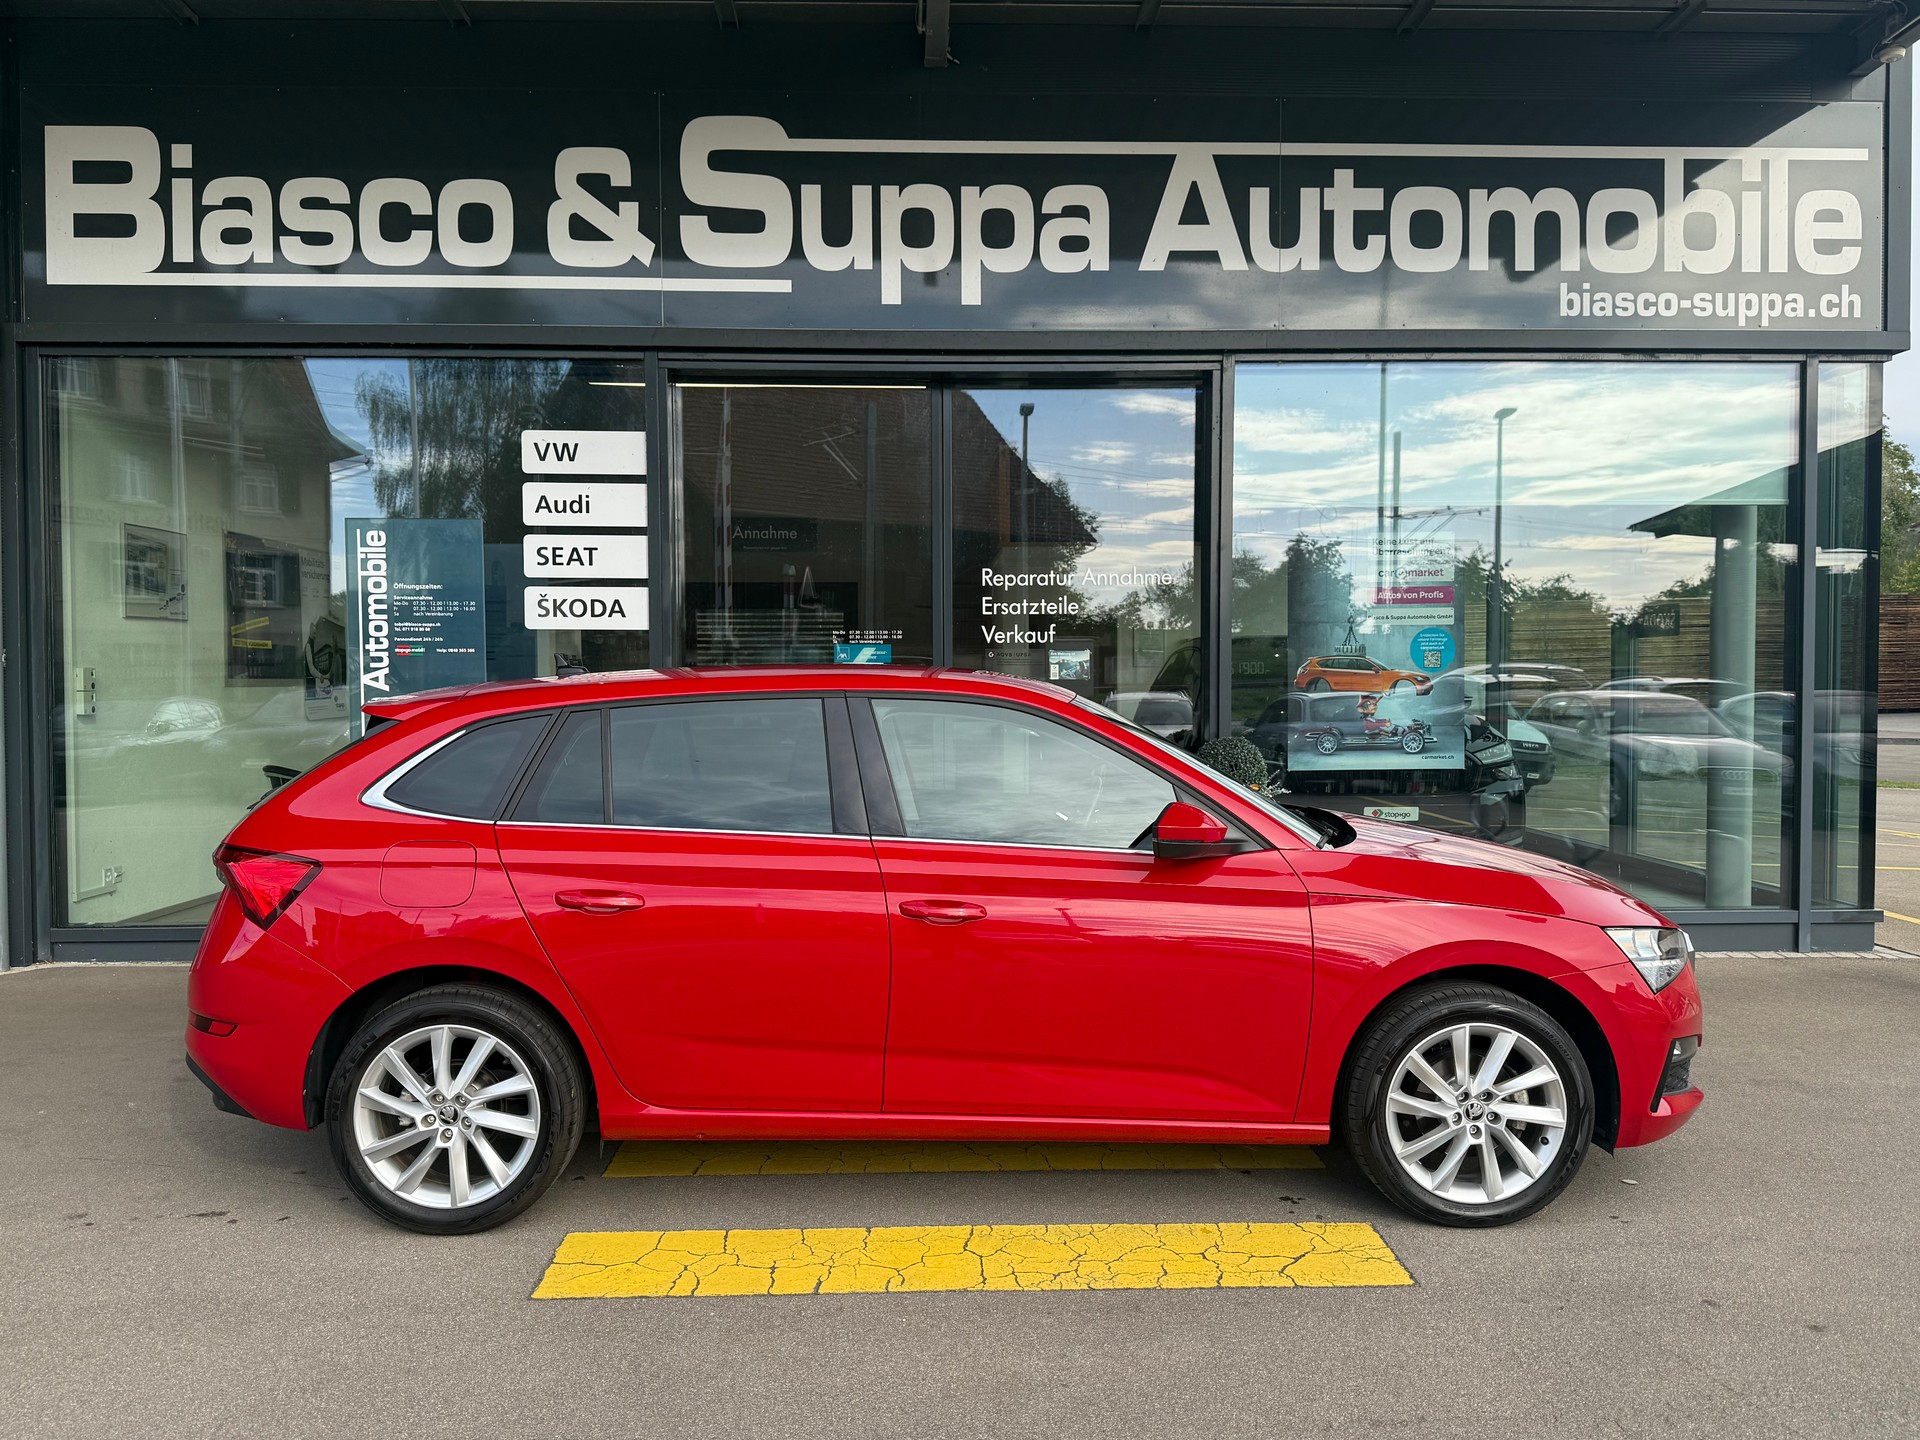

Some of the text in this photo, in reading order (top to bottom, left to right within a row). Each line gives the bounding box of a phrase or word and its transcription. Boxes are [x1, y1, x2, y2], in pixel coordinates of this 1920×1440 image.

[44, 115, 1864, 305] Biasco & Suppa Automobile
[1559, 282, 1862, 327] biasco-suppa.ch
[533, 442, 579, 462] VW
[535, 494, 590, 514] Audi
[732, 525, 798, 539] Annahme
[536, 546, 599, 567] SEAT
[393, 582, 443, 590] Öffnungszeiten:
[981, 567, 1173, 591] Reparatur Annahme
[1419, 591, 1444, 599] Profis
[359, 529, 390, 692] Automobile
[537, 593, 627, 618] ŠKODA
[981, 596, 1079, 615] Ersatzteile
[981, 624, 1056, 644] Verkauf
